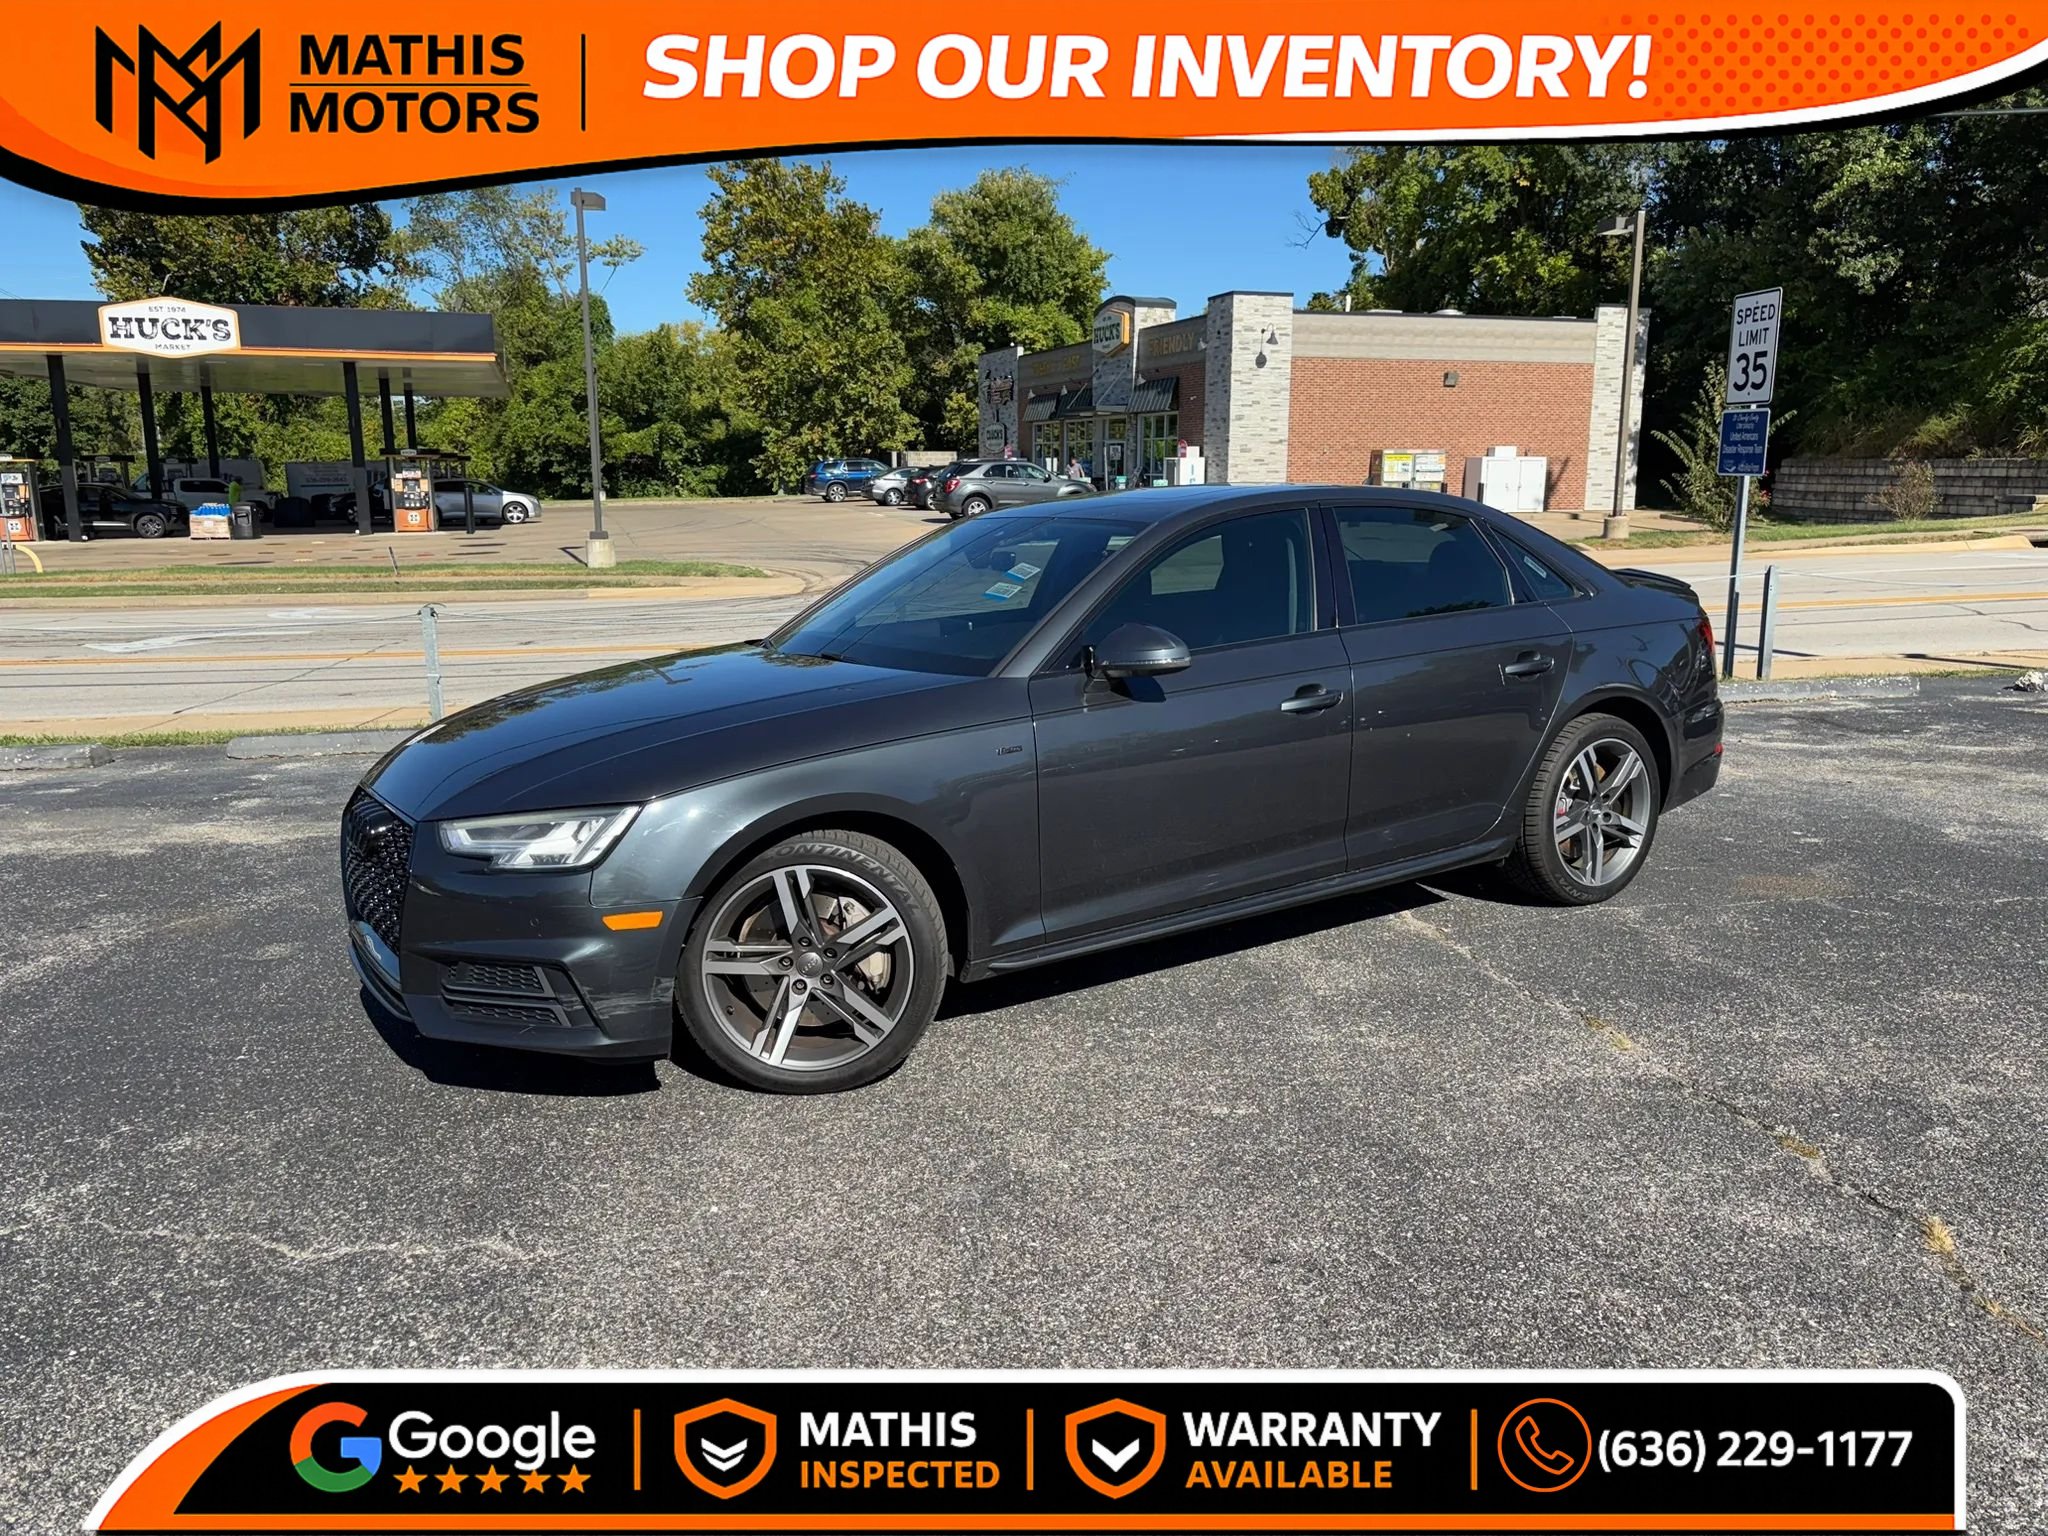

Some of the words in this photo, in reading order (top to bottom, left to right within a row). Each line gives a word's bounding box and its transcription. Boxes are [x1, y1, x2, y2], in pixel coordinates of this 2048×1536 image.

[1736, 303, 1776, 325] SPEED
[108, 316, 232, 342] HUCK'S
[1738, 327, 1770, 347] LIMIT
[1732, 350, 1769, 392] 35
